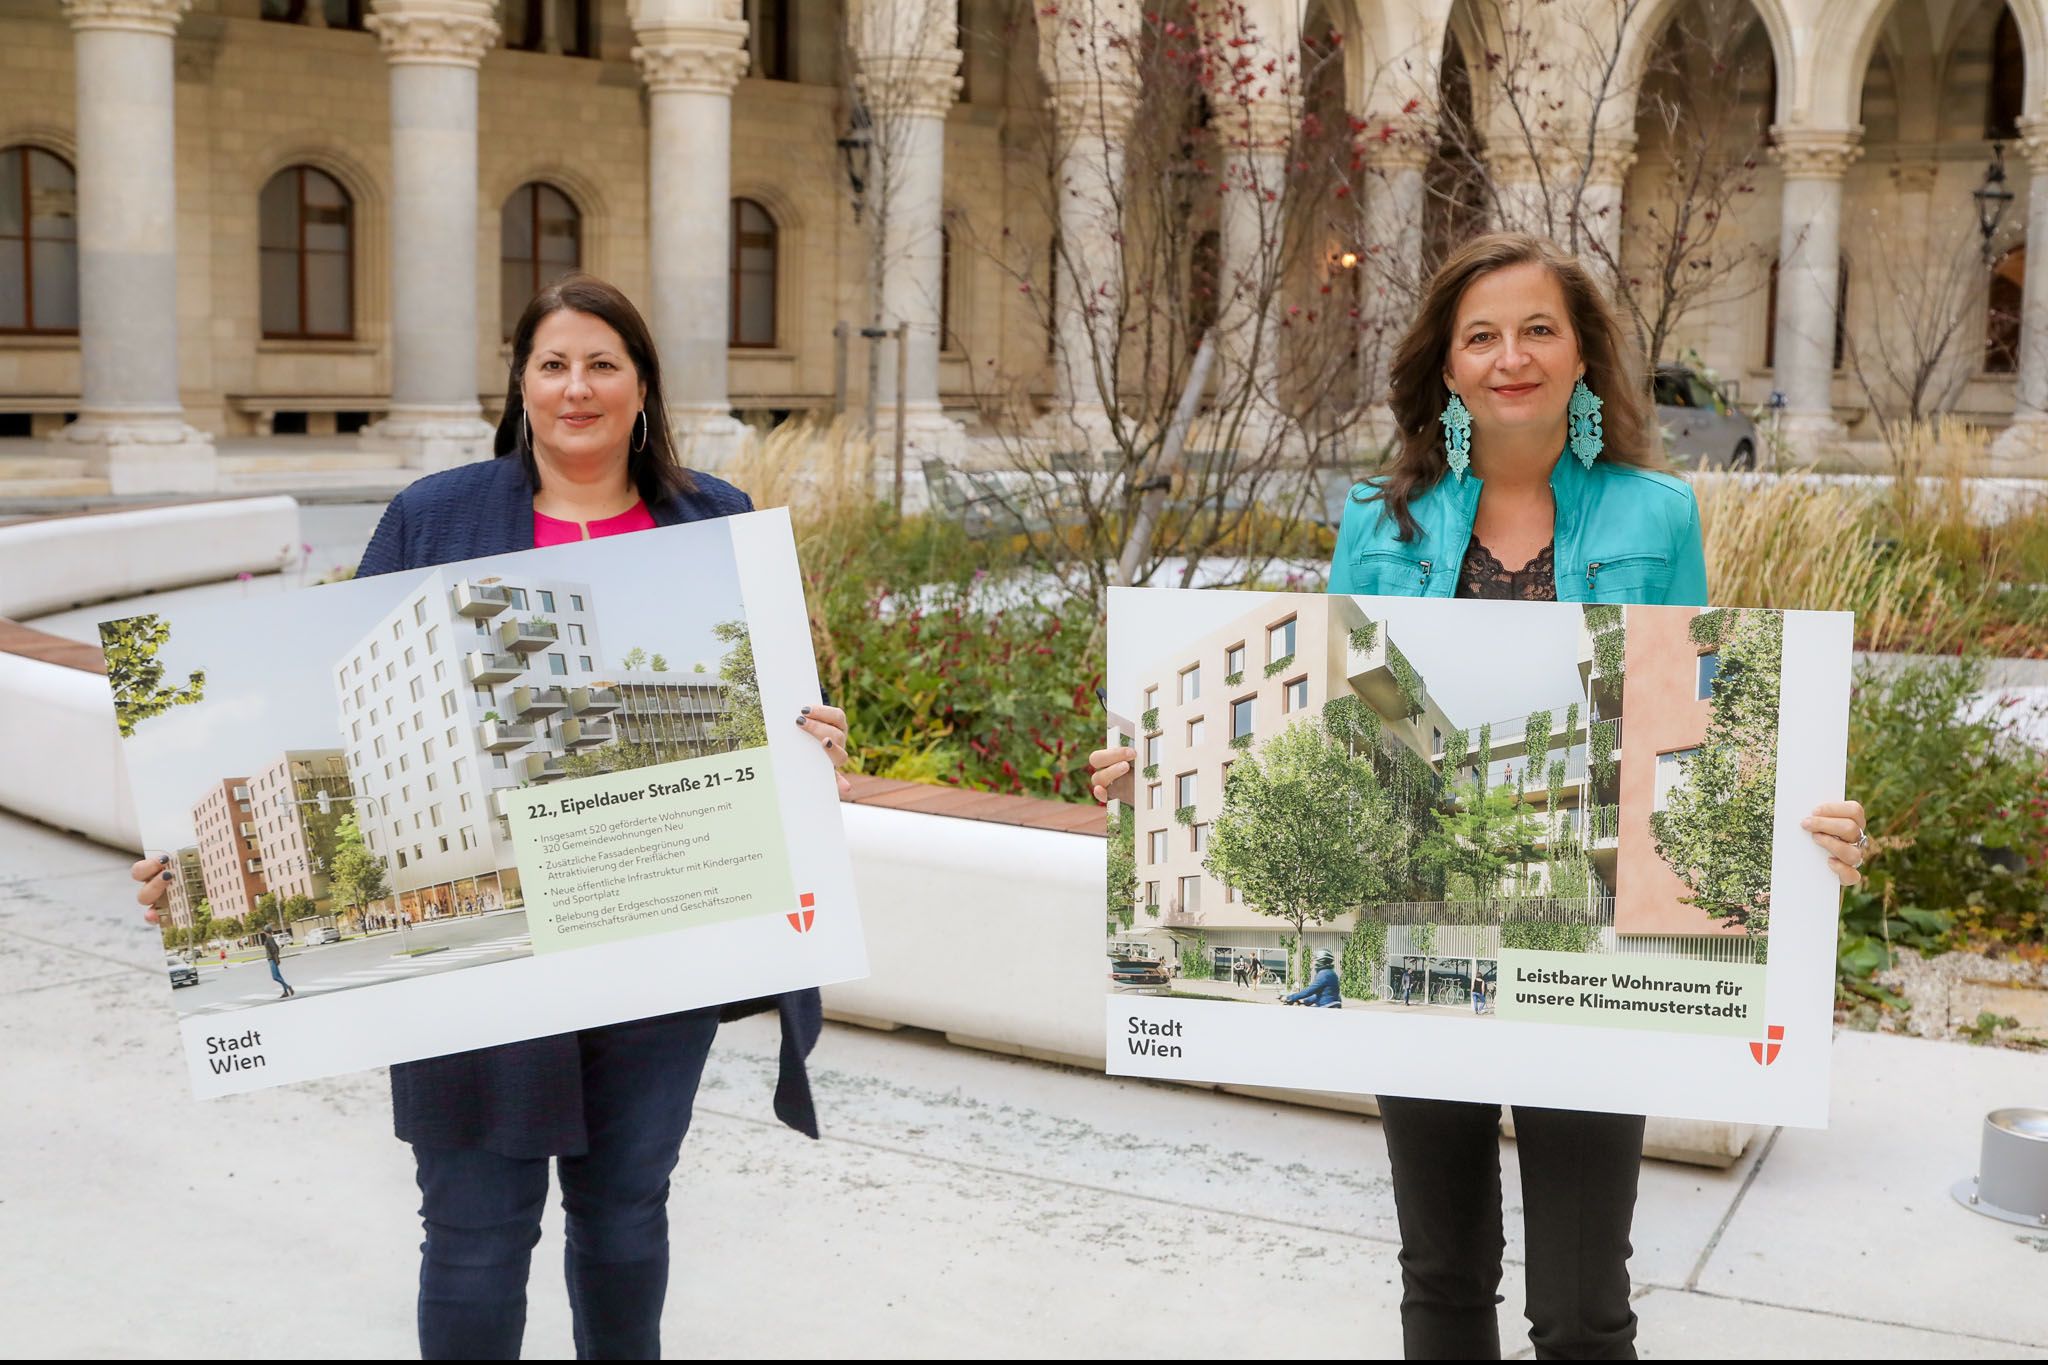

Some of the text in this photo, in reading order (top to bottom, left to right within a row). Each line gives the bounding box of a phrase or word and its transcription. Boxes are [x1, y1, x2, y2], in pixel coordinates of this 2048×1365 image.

[528, 804, 557, 819] 22.,
[560, 792, 645, 814] Eipeldauer
[648, 778, 700, 797] Straße
[540, 802, 733, 843] Insgesamt 520 geförderte Wohnungen mit
[543, 823, 684, 854] 320 Gemeindewohnungen Neu
[546, 832, 710, 870] Zusätzliche Fassadenbegrünung und
[548, 850, 685, 880] Attraktivierung der Freiflächen
[550, 852, 763, 896] Neue öffentliche Infrastruktur mit Kindergarten
[553, 889, 620, 907] und Sportplatz
[556, 887, 718, 923] Belebung der Erdgeschosszonen mit
[558, 892, 752, 934] Gemeinschaftsräumen und Geschäftszonen
[1516, 967, 1742, 996] Leistbarer Wohnraum für
[1515, 992, 1747, 1018] unsere Klimamusterstadt!
[1128, 1016, 1182, 1037] Stadt
[206, 1030, 261, 1054] Stadt
[1128, 1038, 1182, 1058] Wien
[210, 1054, 266, 1074] Wien
